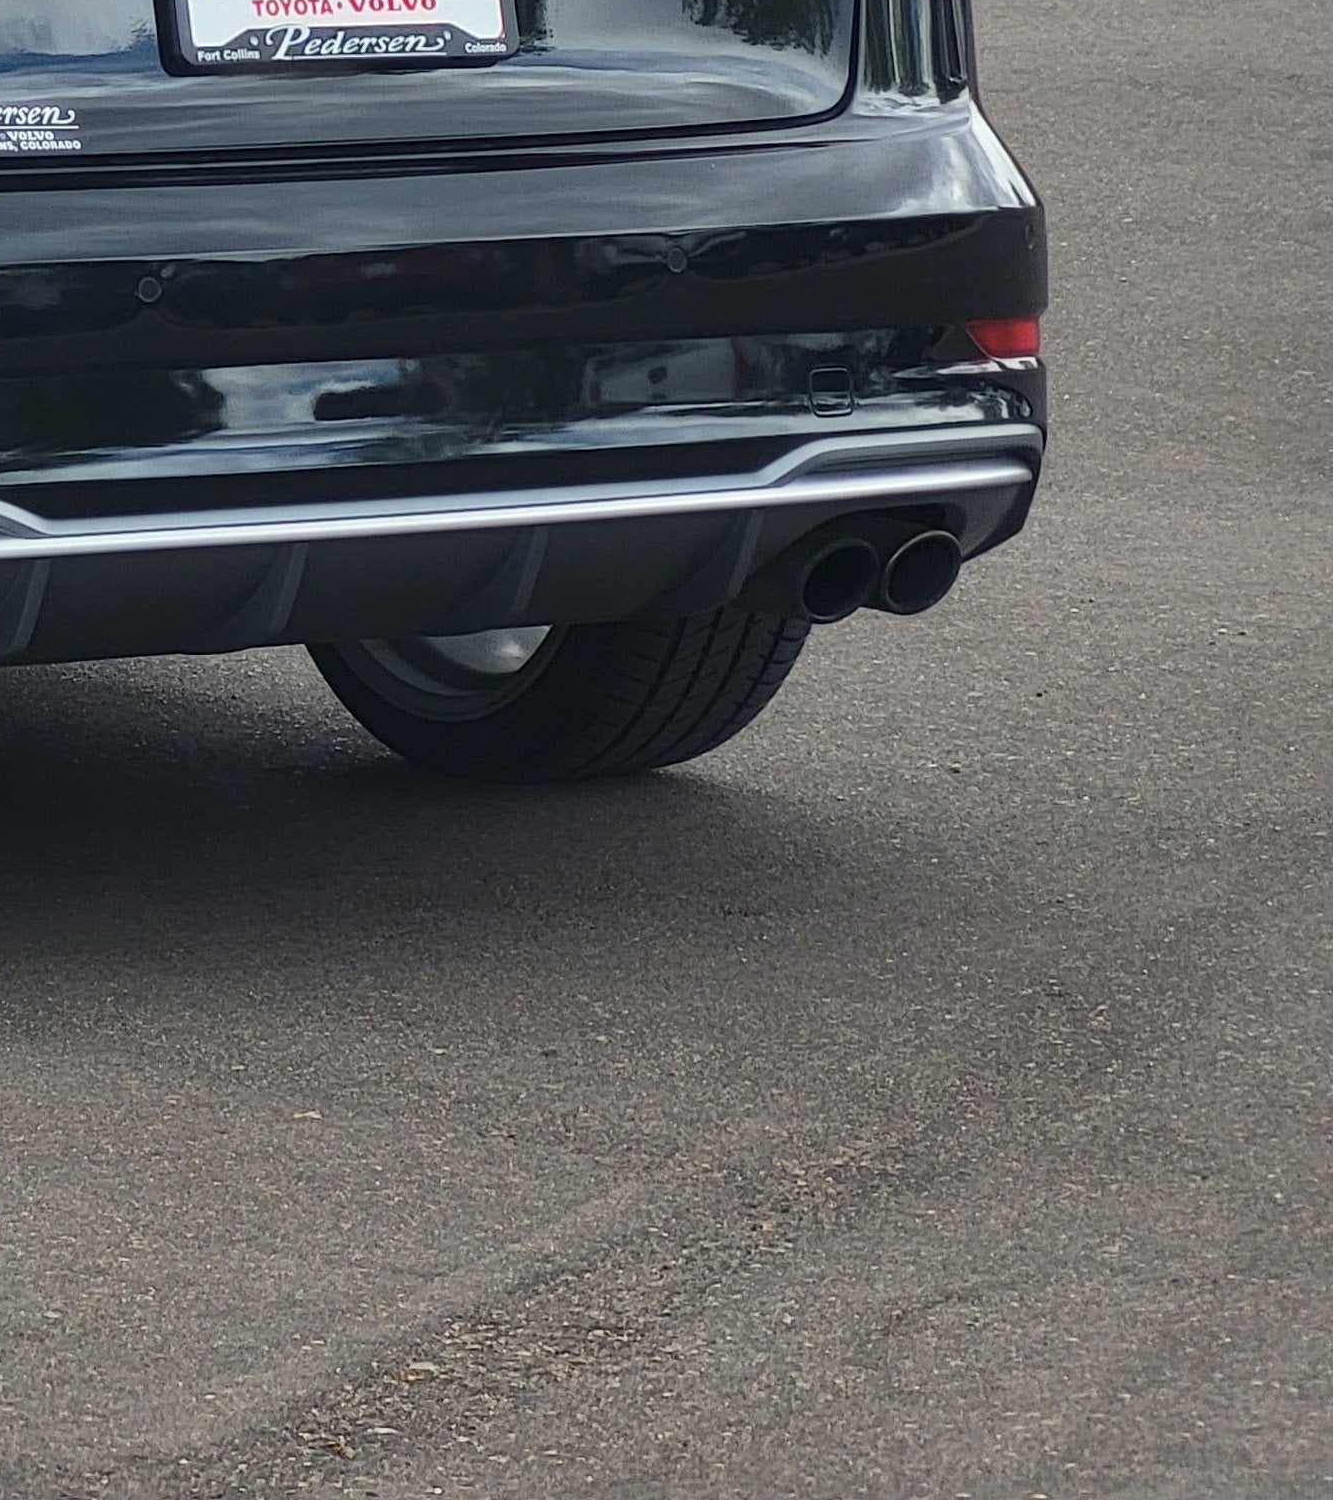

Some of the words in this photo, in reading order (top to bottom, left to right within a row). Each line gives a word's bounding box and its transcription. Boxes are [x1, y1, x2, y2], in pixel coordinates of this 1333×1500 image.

[265, 24, 446, 61] Pedersen
[464, 41, 507, 54] Colorado
[197, 50, 221, 62] Fort
[223, 48, 261, 62] Collins
[8, 130, 55, 141] VOLVO
[20, 140, 82, 151] COLORADO
